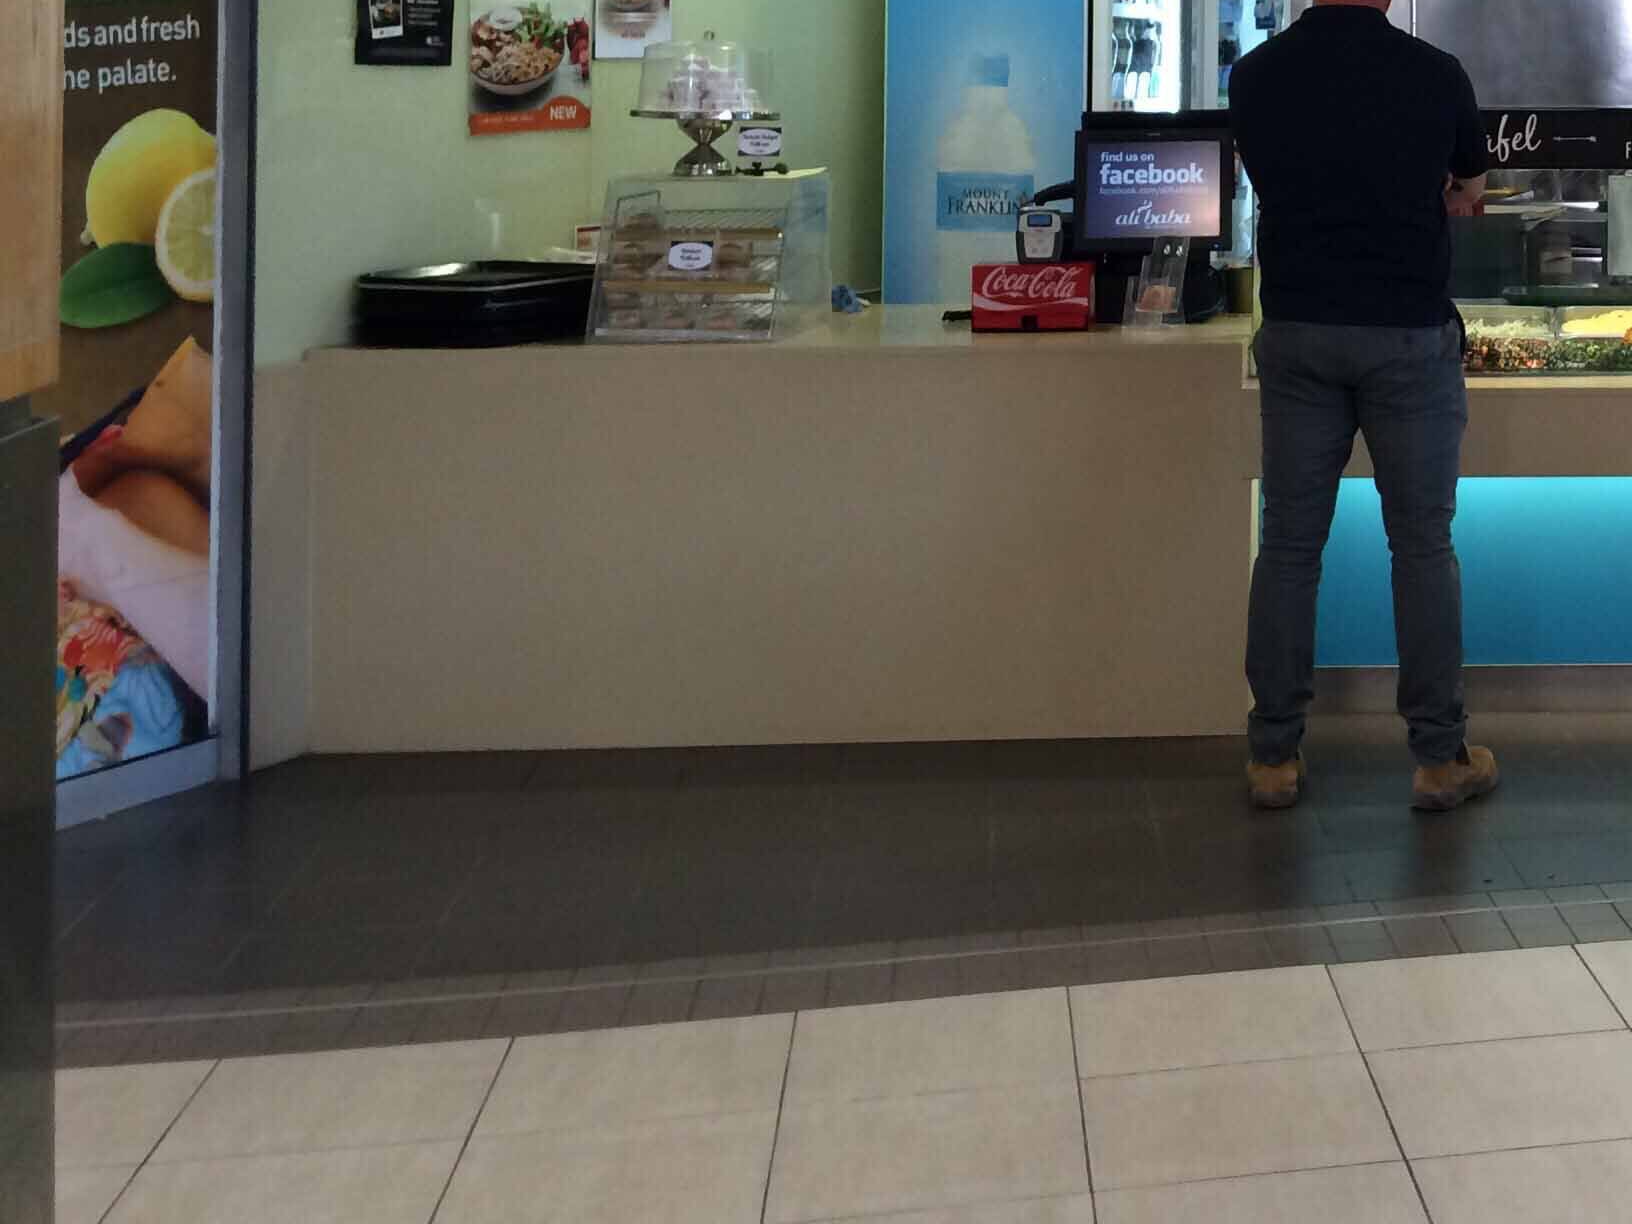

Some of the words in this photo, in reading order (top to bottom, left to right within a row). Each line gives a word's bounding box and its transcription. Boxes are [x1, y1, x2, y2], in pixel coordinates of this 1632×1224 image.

[64, 21, 90, 48] ds
[94, 16, 137, 45] and
[141, 13, 200, 43] fresh
[98, 57, 176, 95] palate.
[550, 104, 577, 120] NEW
[1486, 113, 1541, 162] fel
[1100, 151, 1123, 163] find
[1126, 153, 1138, 163] us
[1140, 152, 1154, 162] on
[1100, 162, 1204, 185] facebook
[962, 187, 1009, 201] MOUNT
[982, 265, 1084, 299] Coca-Cola
